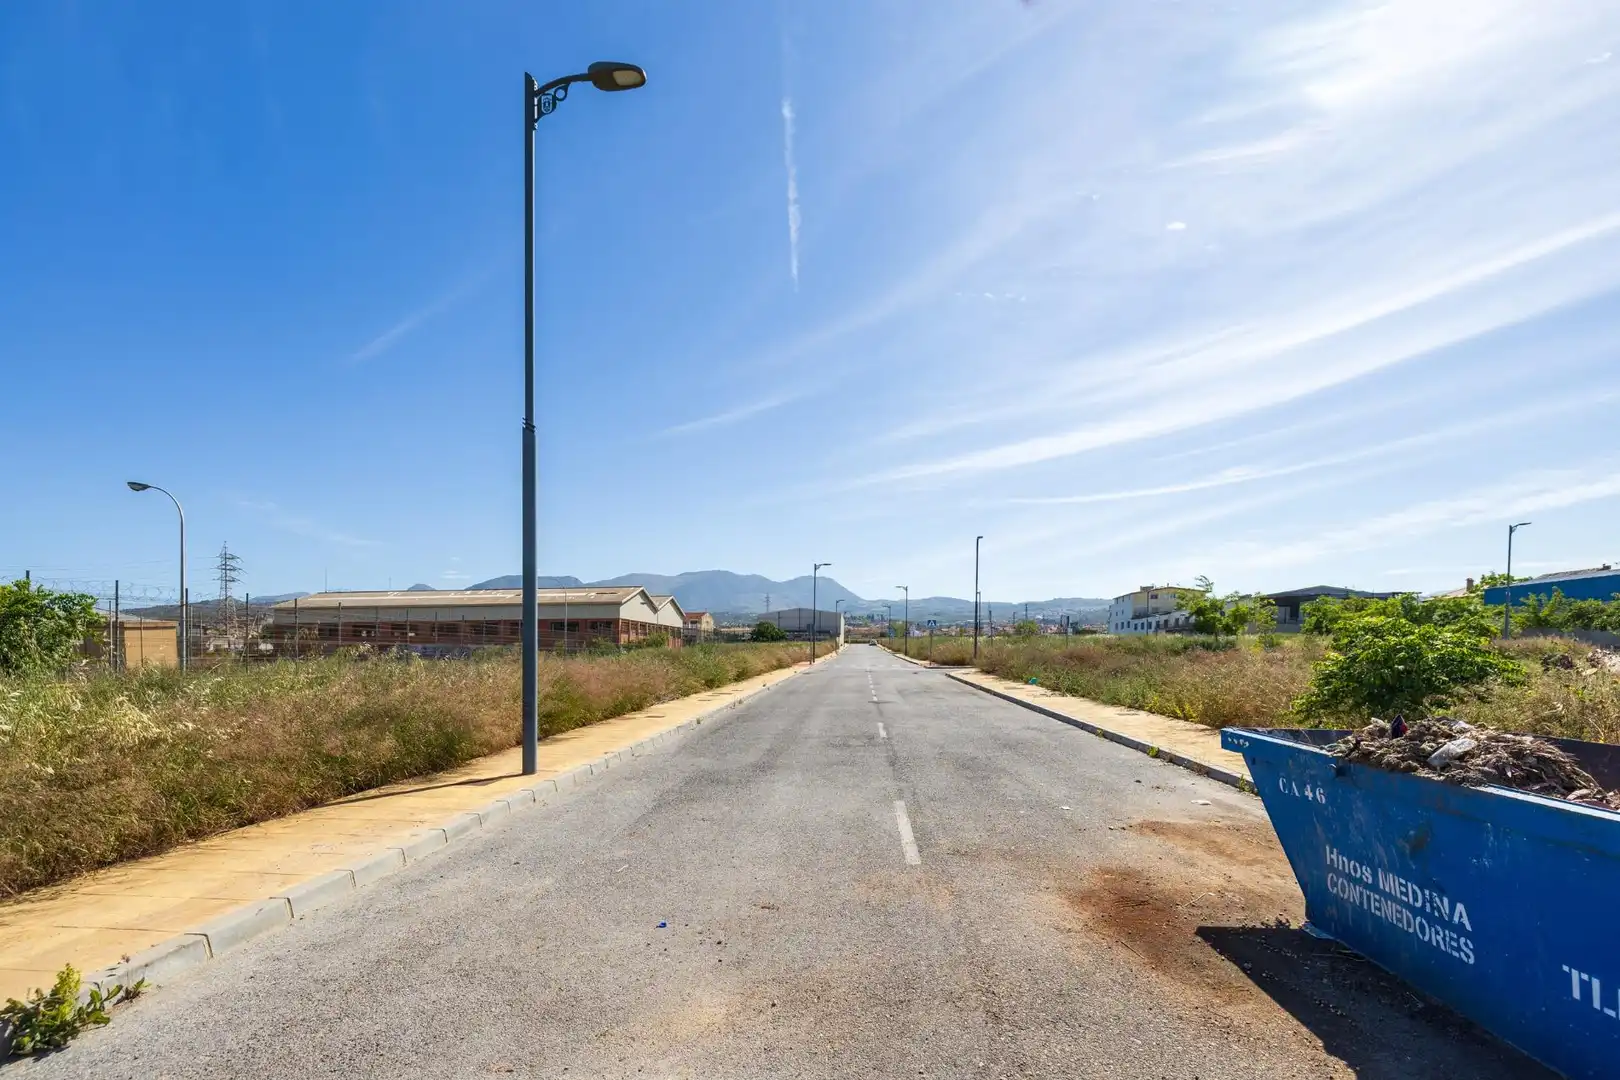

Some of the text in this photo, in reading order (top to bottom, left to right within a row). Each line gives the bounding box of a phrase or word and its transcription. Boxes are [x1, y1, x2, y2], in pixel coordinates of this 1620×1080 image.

[1279, 777, 1326, 804] CA 46
[1326, 844, 1472, 932] Hnos MEDINA
[1327, 873, 1474, 965] CONTENEDORES
[1562, 964, 1620, 1021] TL
